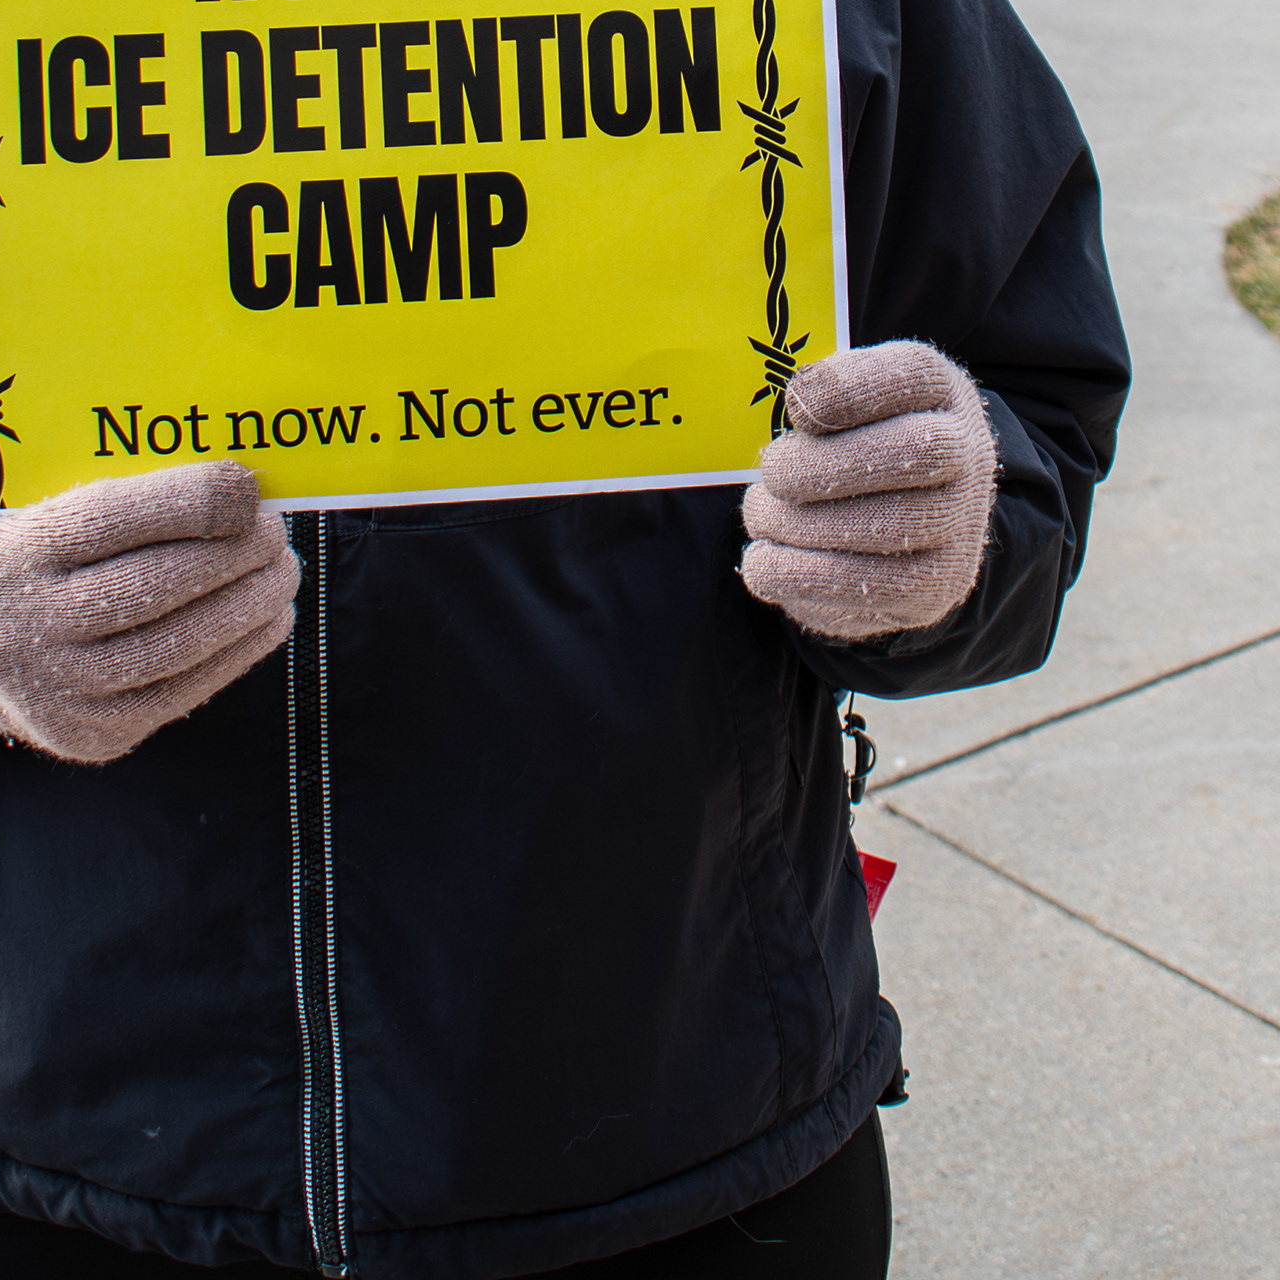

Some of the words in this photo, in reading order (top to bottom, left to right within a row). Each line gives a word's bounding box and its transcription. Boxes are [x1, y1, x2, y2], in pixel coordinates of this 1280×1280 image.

[16, 29, 172, 166] ICE
[200, 6, 722, 157] DETENTION
[226, 171, 529, 311] CAMP
[91, 401, 212, 457] Not
[225, 403, 381, 451] now.
[397, 387, 517, 441] Not
[531, 385, 683, 433] ever.
